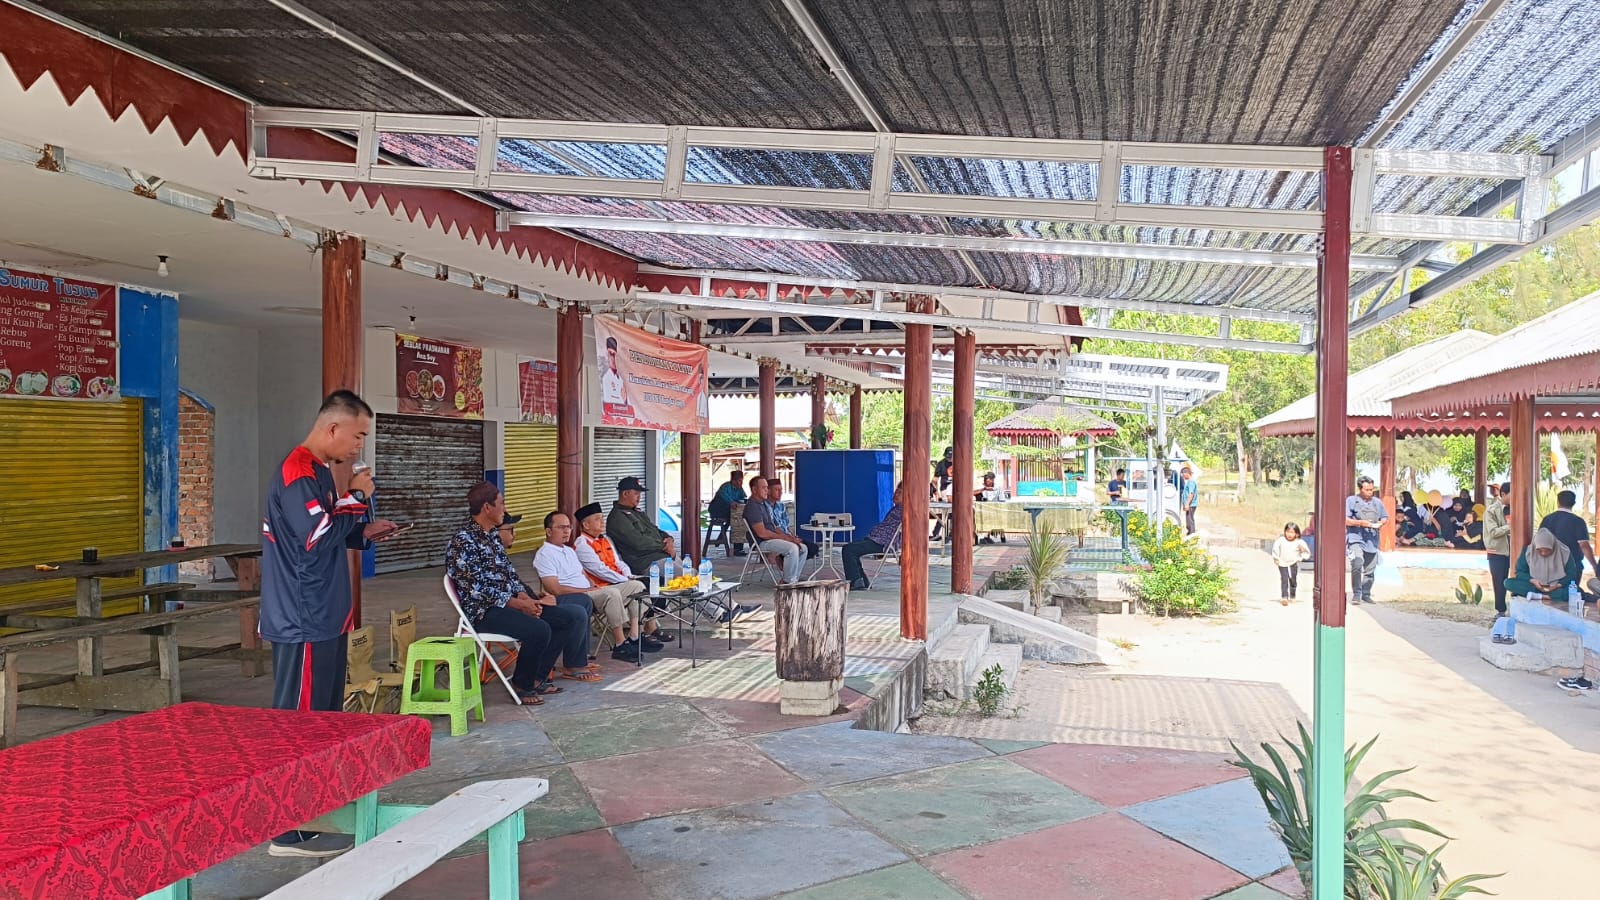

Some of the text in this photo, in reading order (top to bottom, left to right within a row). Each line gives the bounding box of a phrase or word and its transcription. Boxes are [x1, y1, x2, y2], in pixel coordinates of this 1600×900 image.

[14, 308, 44, 320] Goreng
[13, 318, 35, 328] Kuah
[37, 319, 54, 330] Ikan
[1, 327, 27, 337] Rebus
[68, 325, 98, 336] Campu
[0, 337, 32, 350] Goreng
[69, 335, 90, 344] Buah
[58, 344, 74, 353] Pop
[59, 353, 77, 363] Kopi
[59, 364, 77, 373] Kopi
